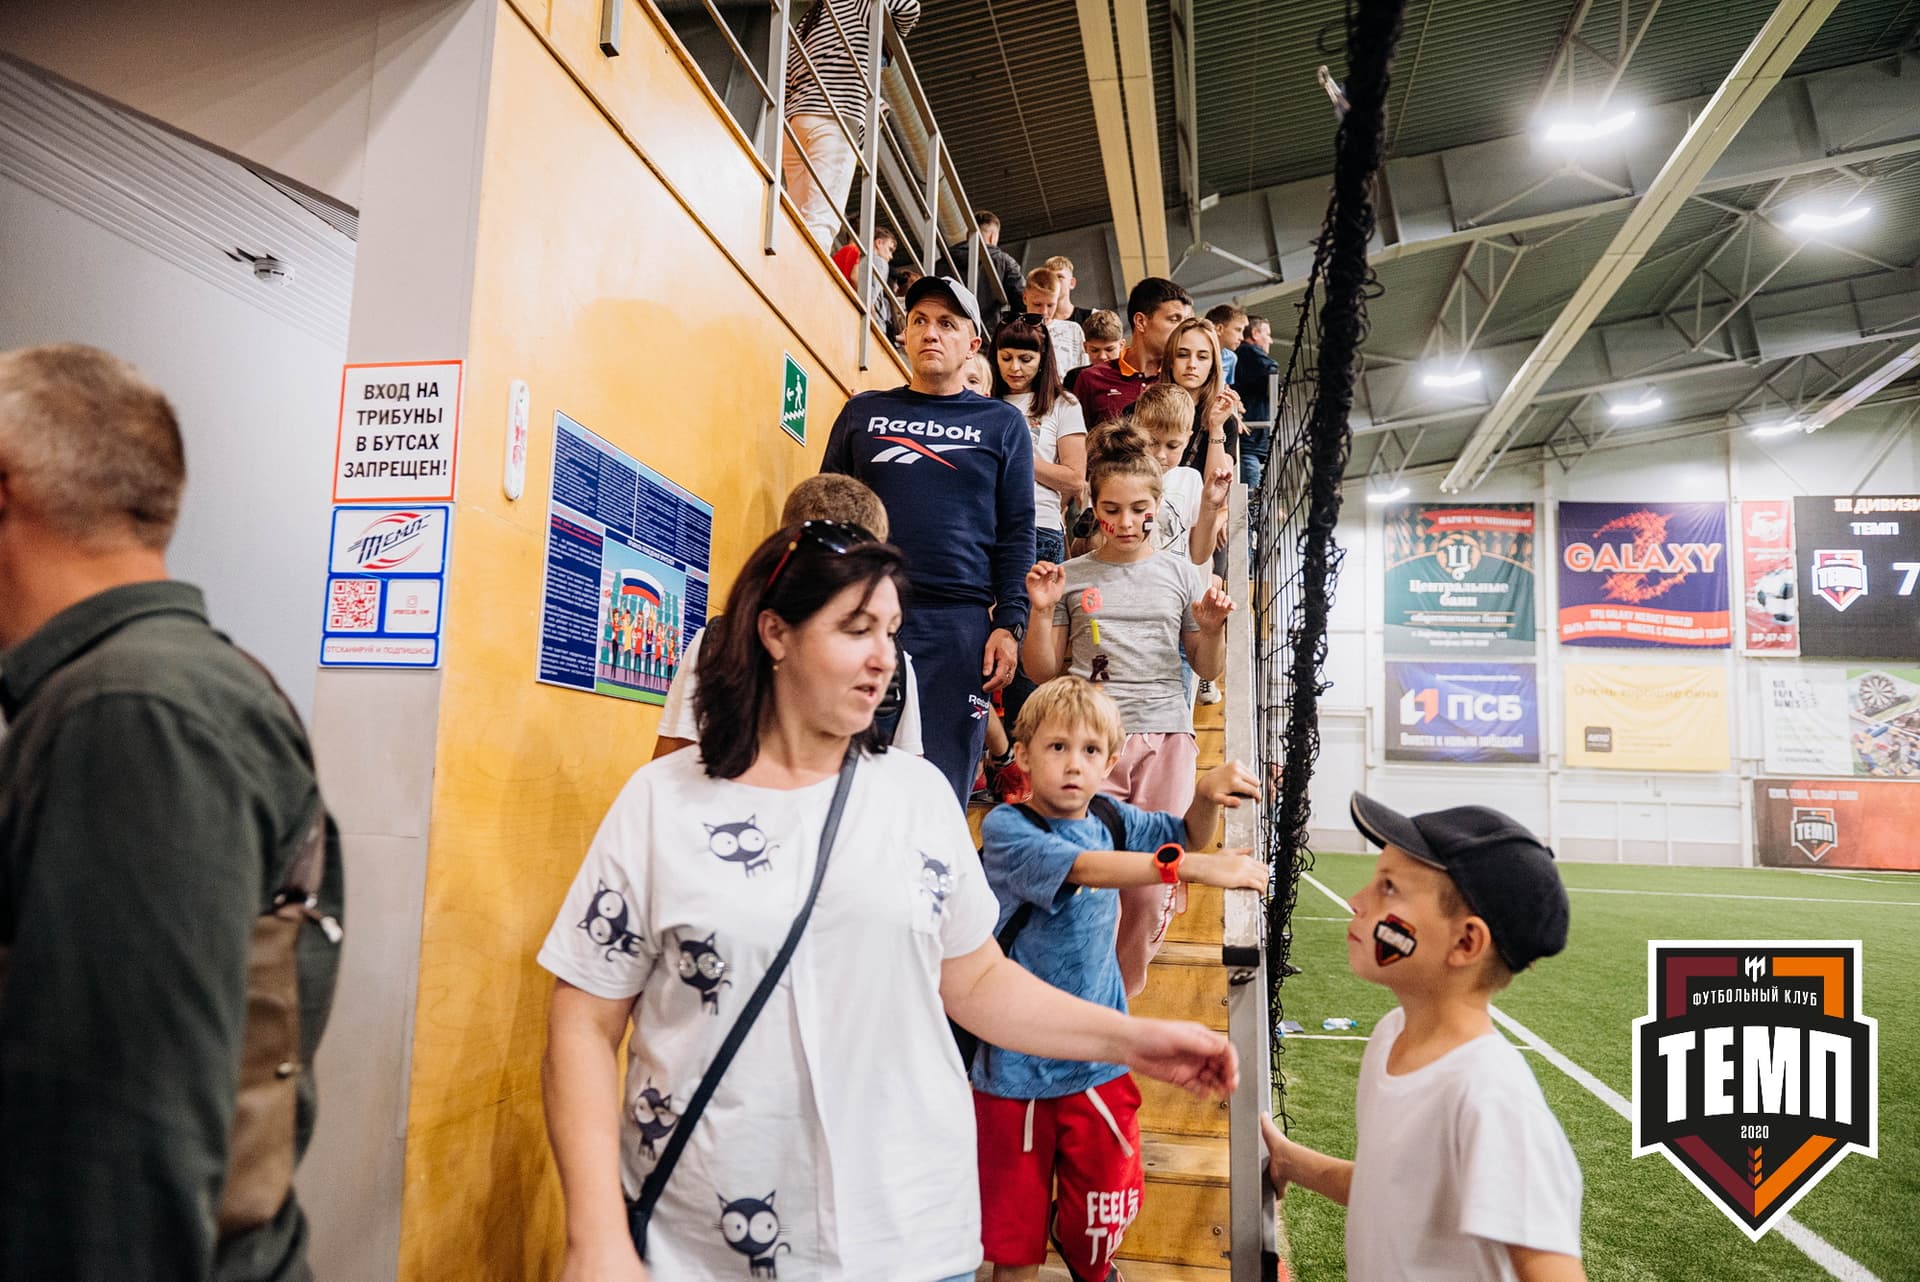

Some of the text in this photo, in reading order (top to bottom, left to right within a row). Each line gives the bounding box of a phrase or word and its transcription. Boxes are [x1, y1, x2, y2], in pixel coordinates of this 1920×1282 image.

[363, 382, 439, 401] ВХОД НА
[356, 407, 443, 426] ТРИБУНЫ
[867, 416, 982, 443] Reebok
[356, 433, 440, 451] В БУТСАХ
[344, 459, 448, 480] ЗАПРЕЩЕН!
[1850, 522, 1899, 535] ТЕМП
[1564, 542, 1722, 573] GALAXY
[1892, 562, 1920, 595] 7
[1448, 694, 1523, 721] ПСБ
